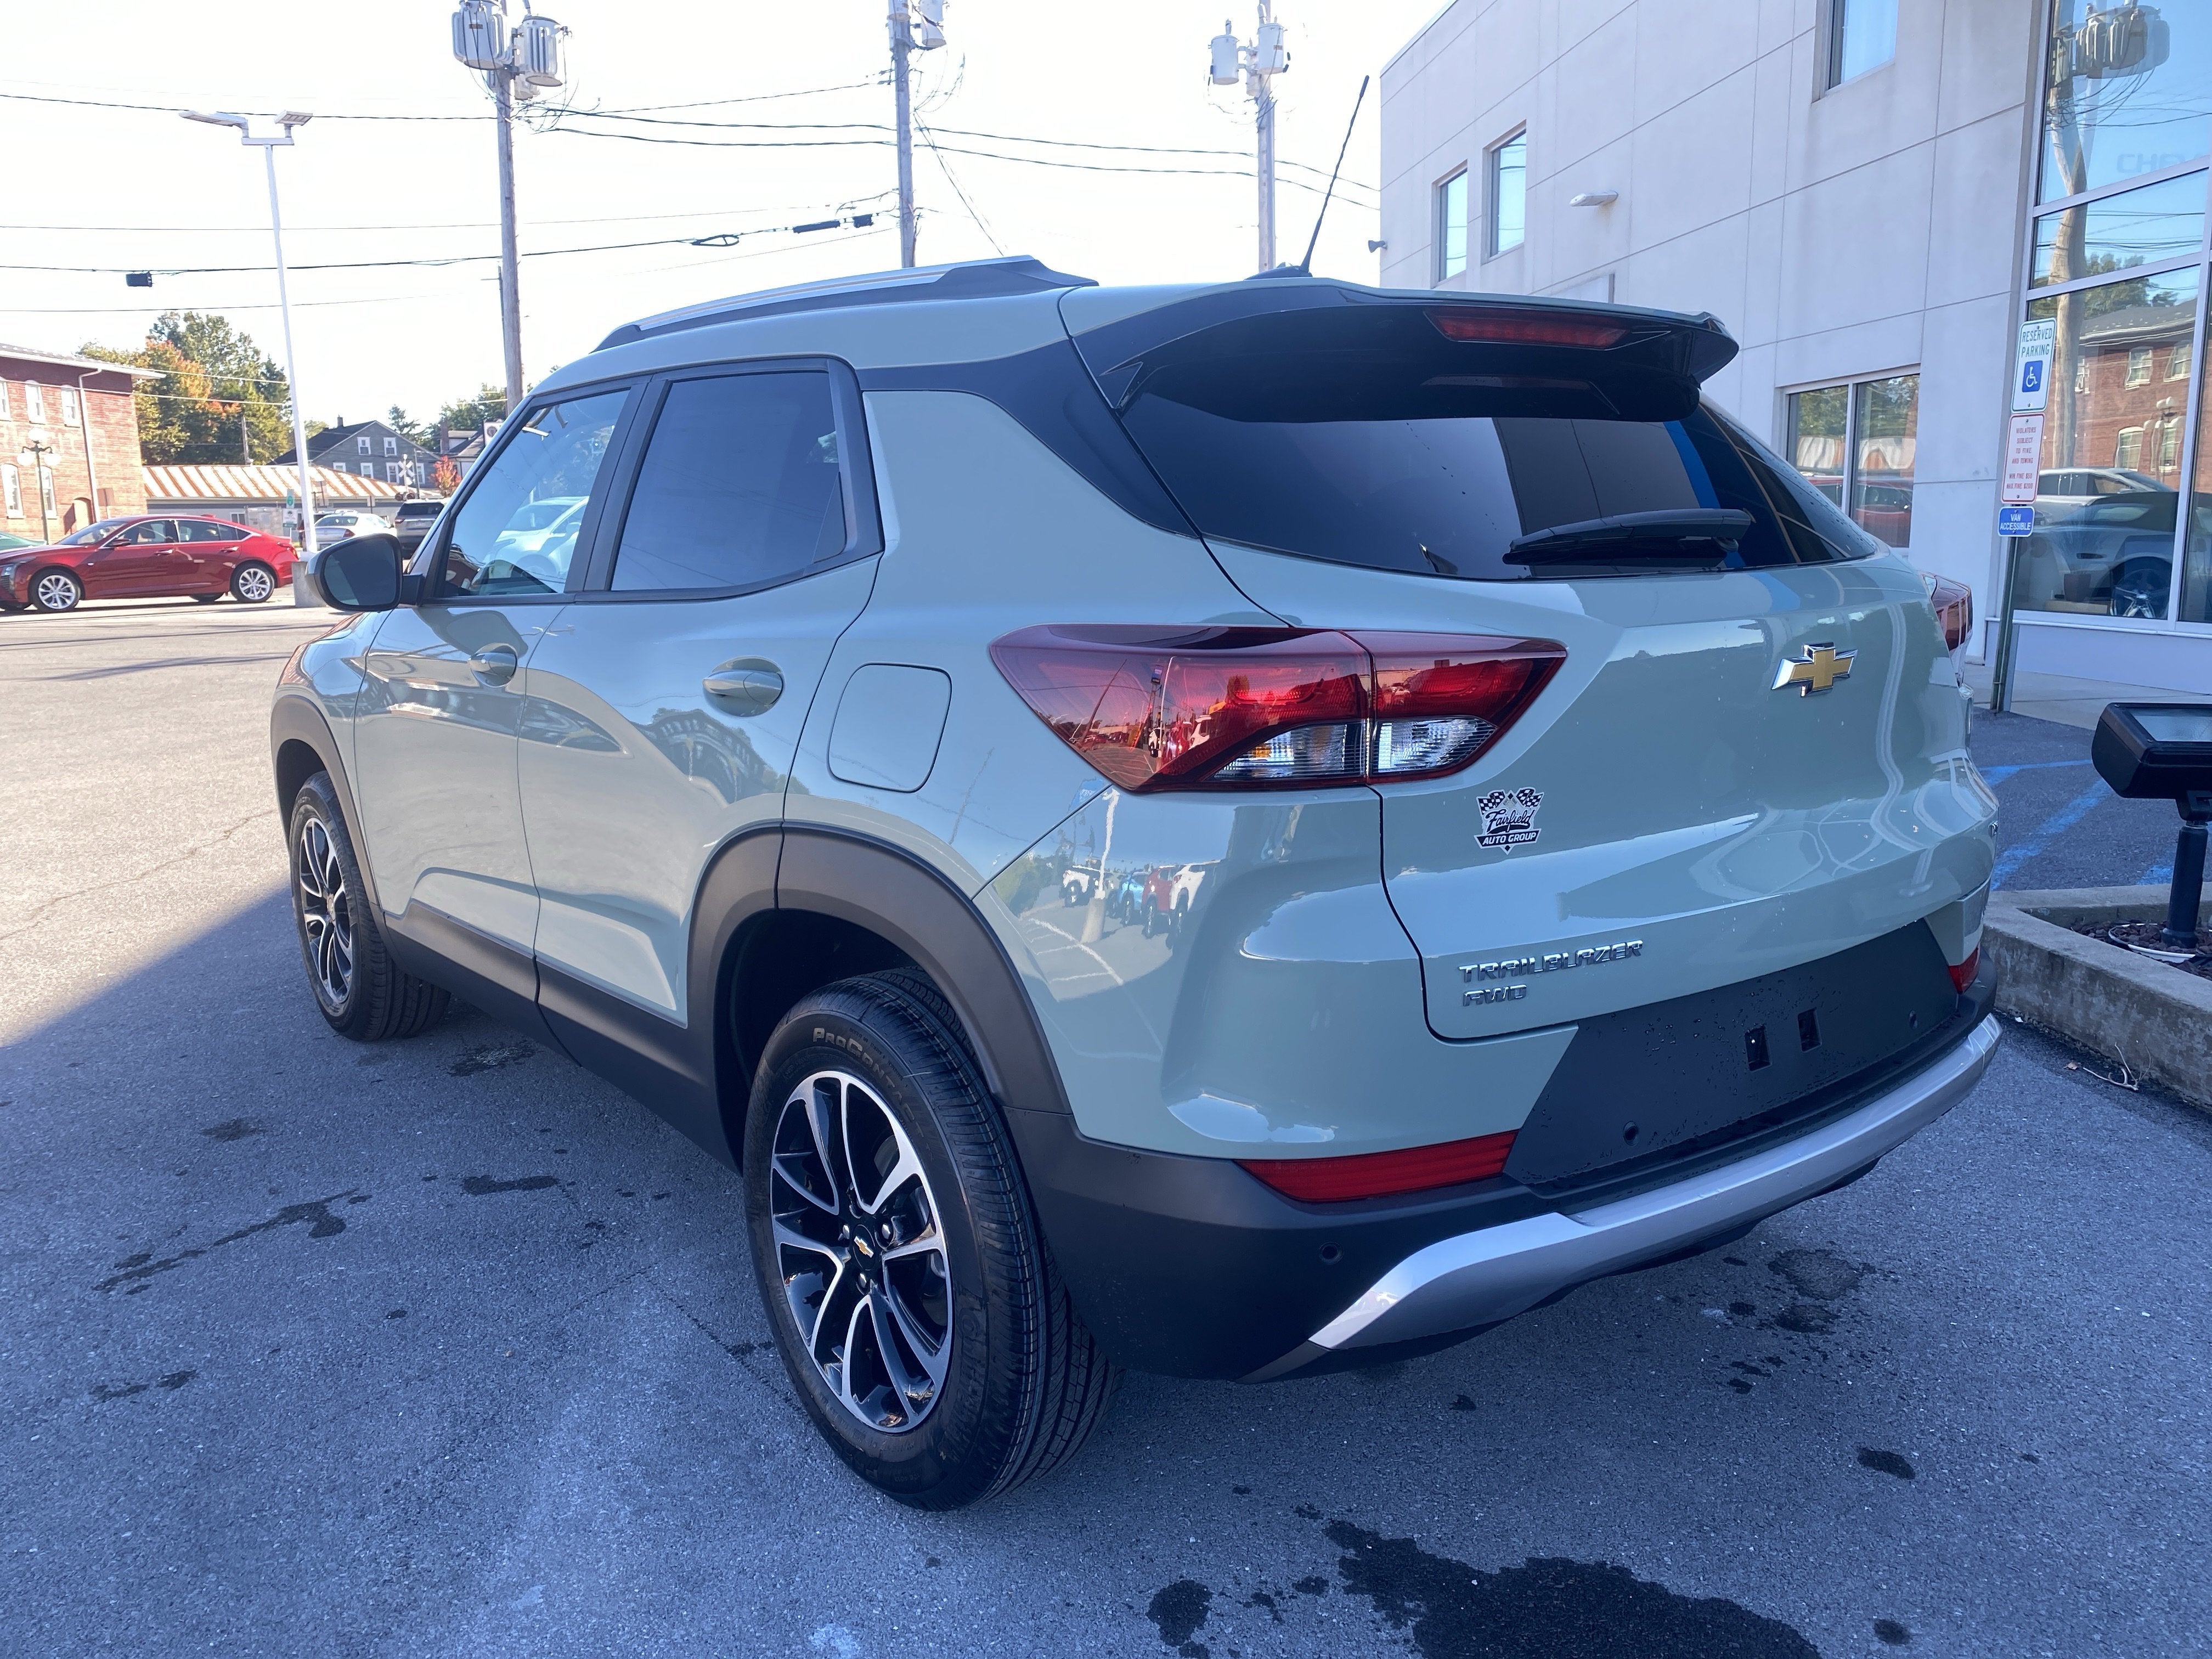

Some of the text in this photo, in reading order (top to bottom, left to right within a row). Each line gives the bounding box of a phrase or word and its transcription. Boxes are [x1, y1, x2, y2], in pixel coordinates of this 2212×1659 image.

[2022, 328, 2052, 342] RESERVED
[2021, 343, 2050, 358] PARKING
[2010, 514, 2022, 522] VAN
[2000, 522, 2032, 531] ACCESSIBLE
[1485, 808, 1536, 833] Fairfield
[1482, 832, 1537, 845] AUTO GROUP
[1457, 939, 1644, 983] TRAILBLAZER
[1462, 984, 1527, 1007] AWD
